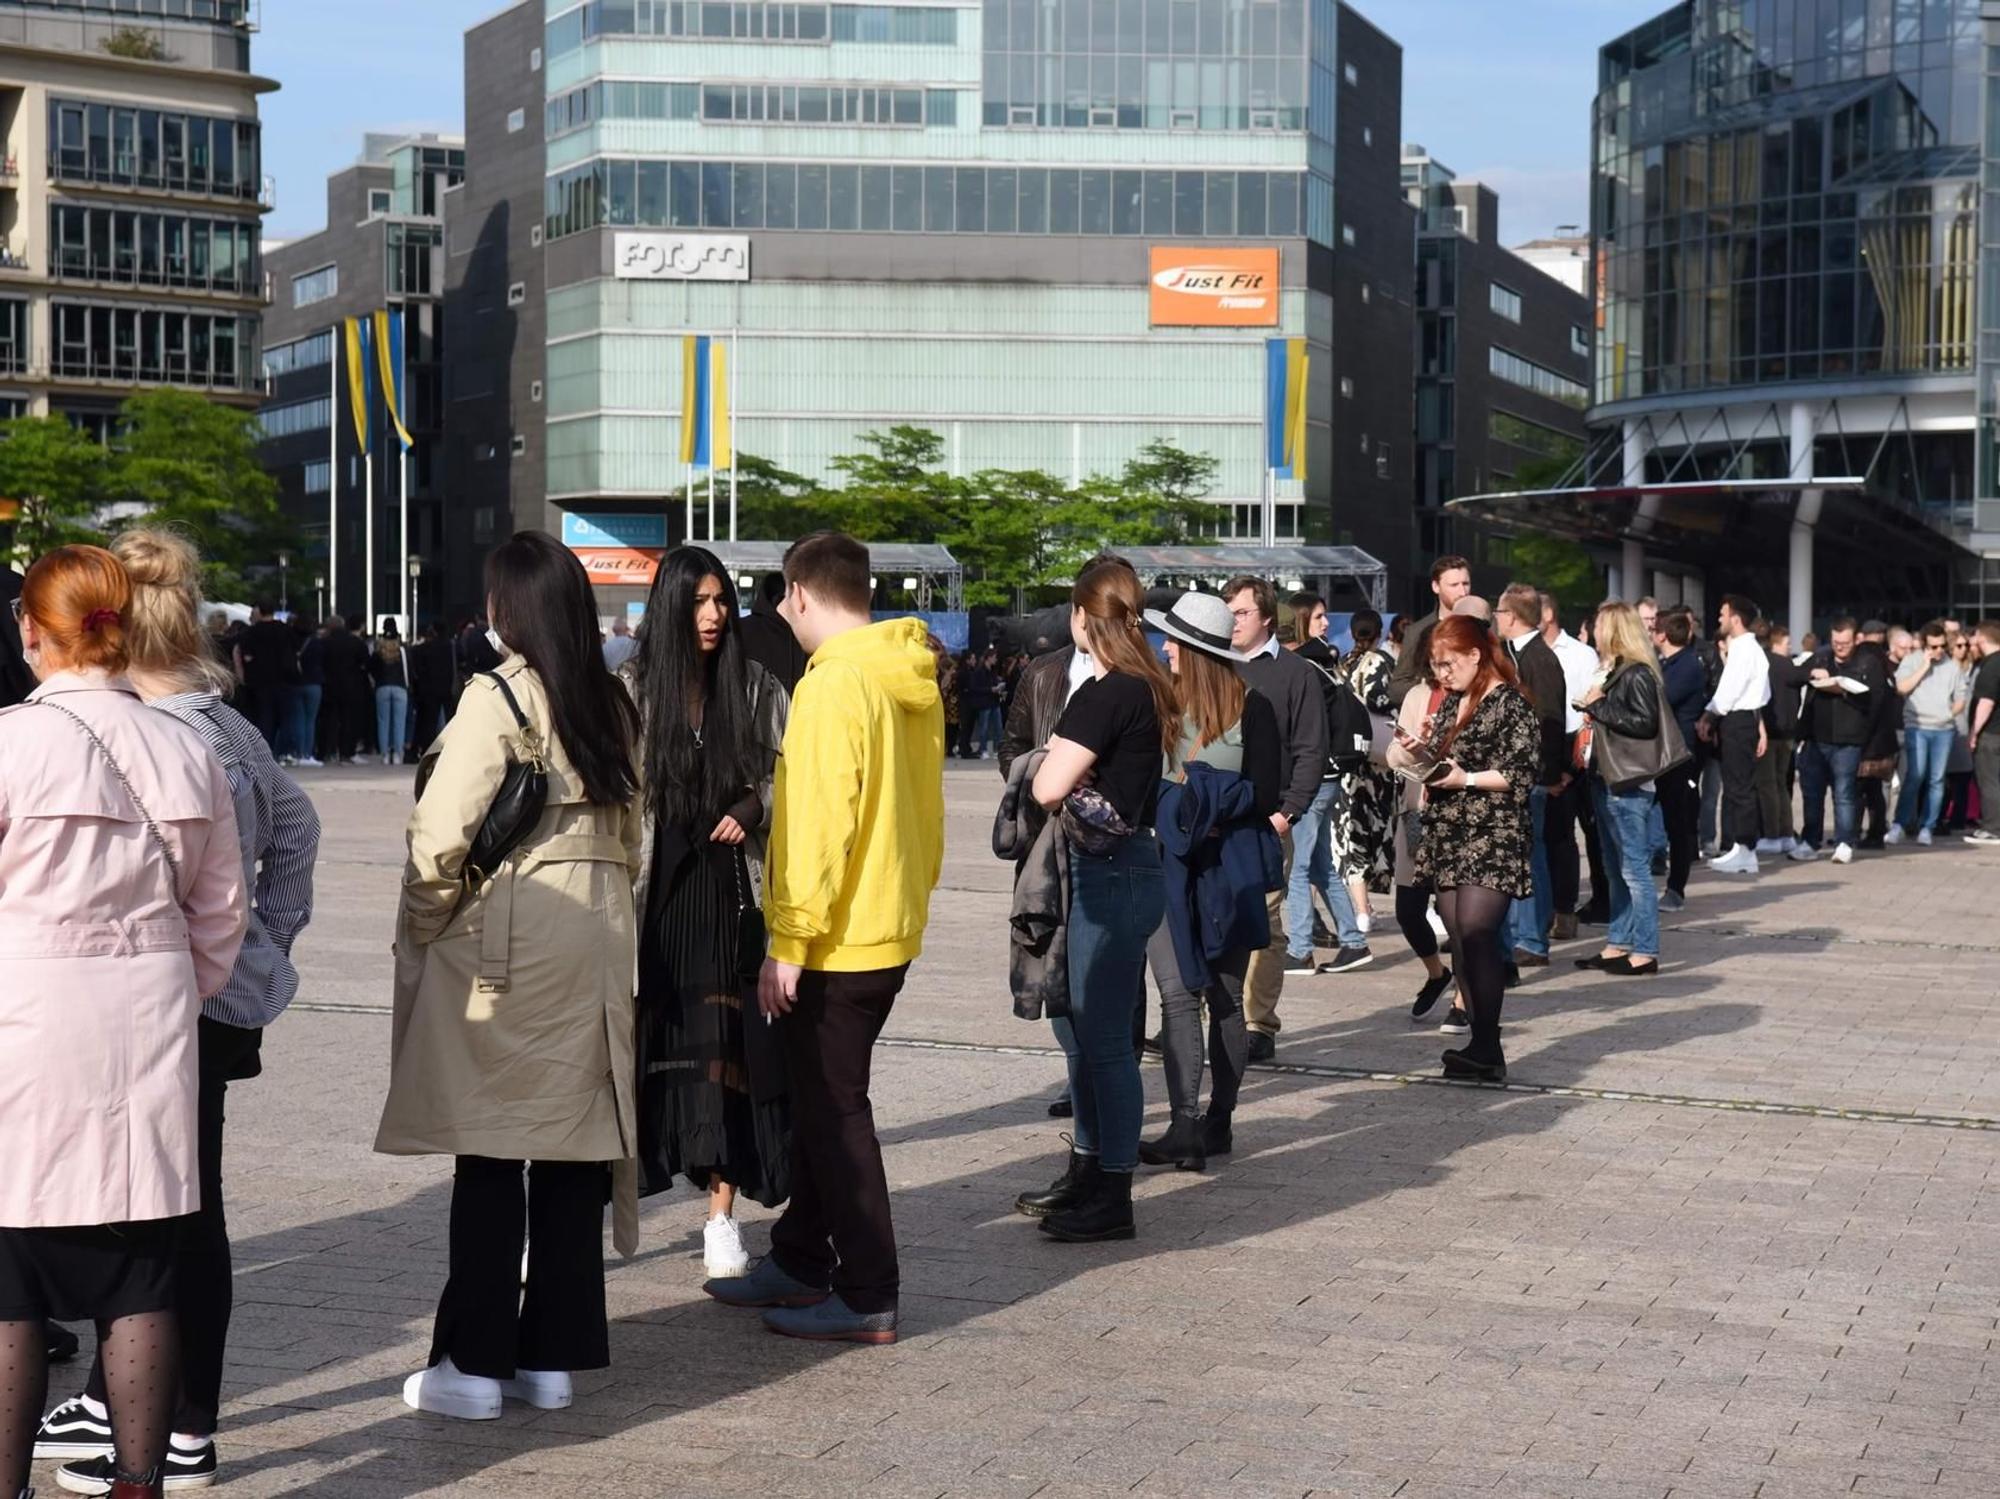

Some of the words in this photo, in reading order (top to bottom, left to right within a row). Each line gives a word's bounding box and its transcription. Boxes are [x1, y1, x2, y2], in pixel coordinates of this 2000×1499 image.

[1168, 270, 1224, 289] Just
[1229, 273, 1264, 289] Fit
[584, 557, 622, 570] Just
[625, 558, 650, 570] Fit
